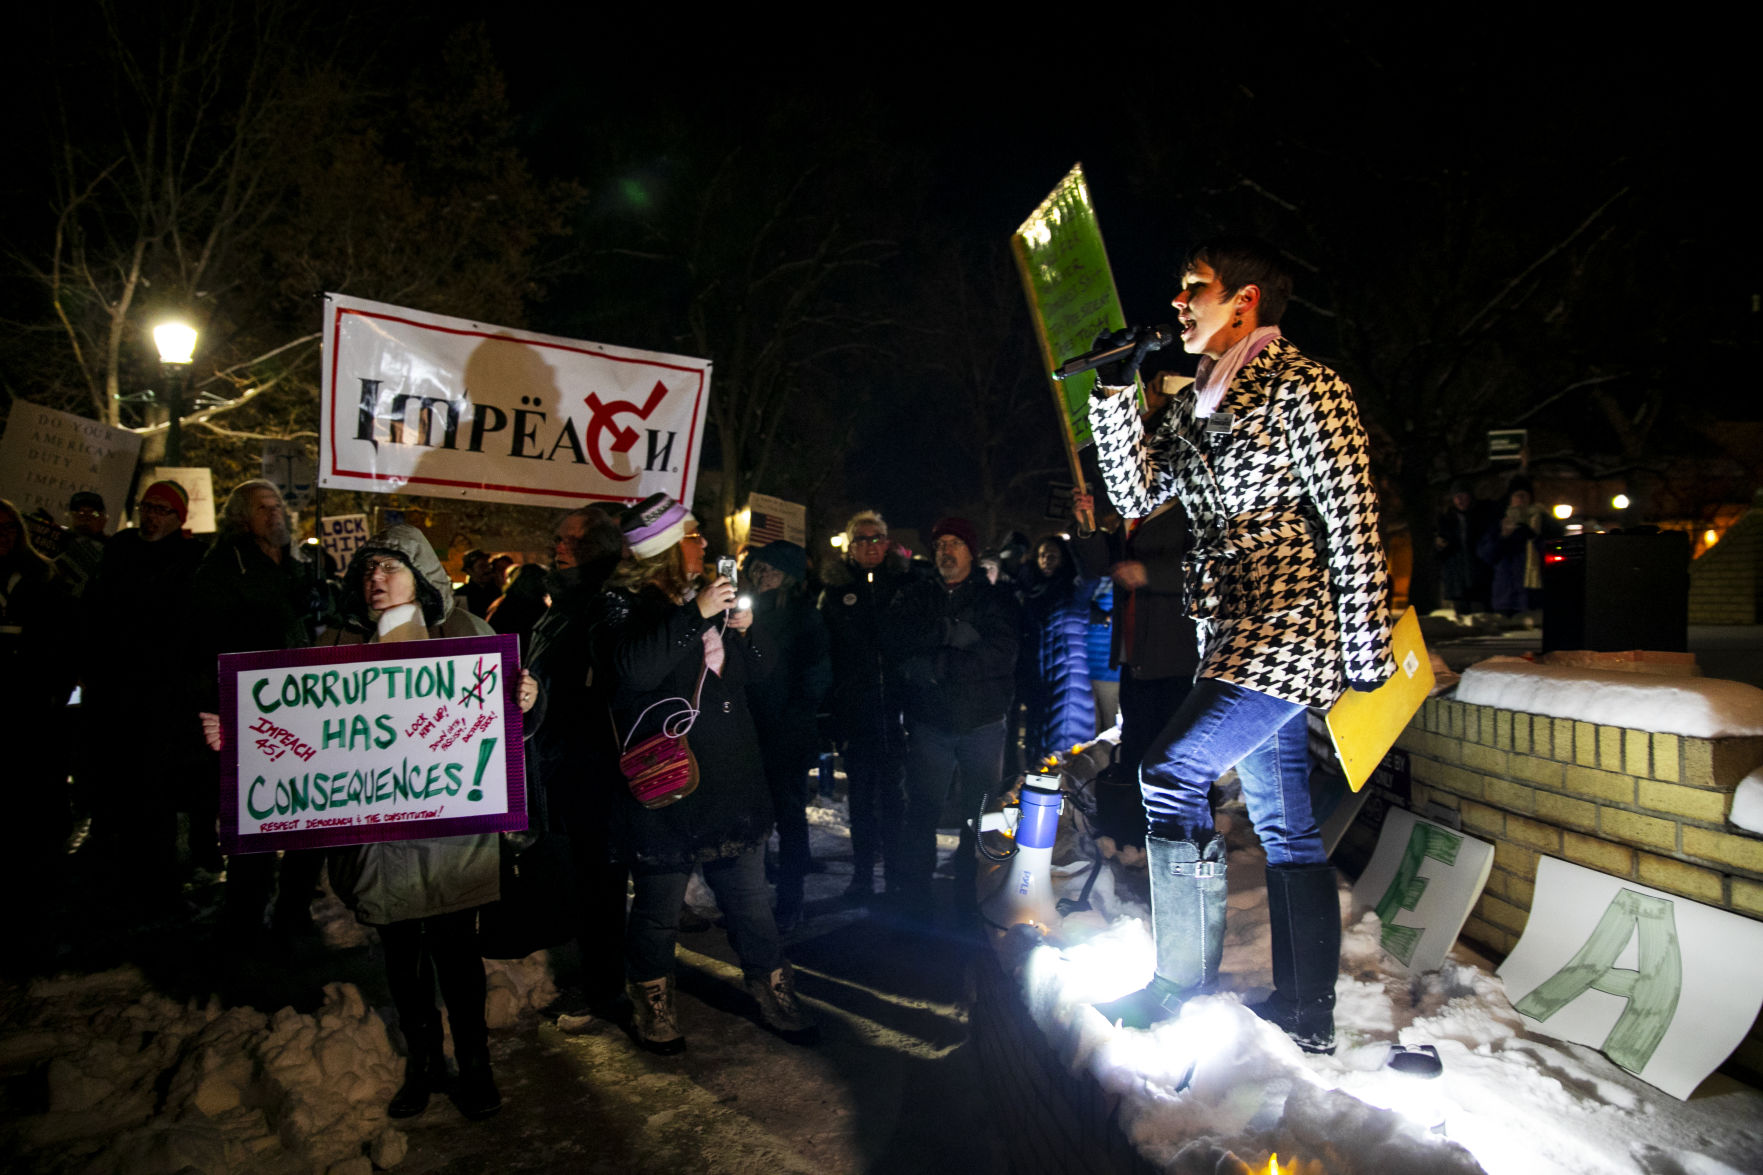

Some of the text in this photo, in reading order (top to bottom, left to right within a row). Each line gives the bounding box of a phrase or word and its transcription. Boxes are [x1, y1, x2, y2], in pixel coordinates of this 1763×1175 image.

[39, 414, 112, 440] DO YOUR
[28, 448, 72, 468] DUTY
[322, 518, 365, 536] LOCK
[324, 535, 366, 552] HIM
[252, 660, 455, 714] CORRUPTION
[321, 714, 397, 751] HAS
[404, 713, 428, 738] LOCK
[419, 704, 449, 739] HIM UP!
[248, 716, 317, 762] IMPEACH
[255, 738, 287, 763] 45!
[247, 737, 498, 821] CONSEQUENCES!
[260, 820, 300, 833] RESPECT
[305, 816, 353, 830] DEMOCRACY
[365, 813, 380, 825] THE
[384, 805, 444, 822] CONSTITUTION!
[1374, 822, 1464, 968] E
[1514, 888, 1682, 1075] A
